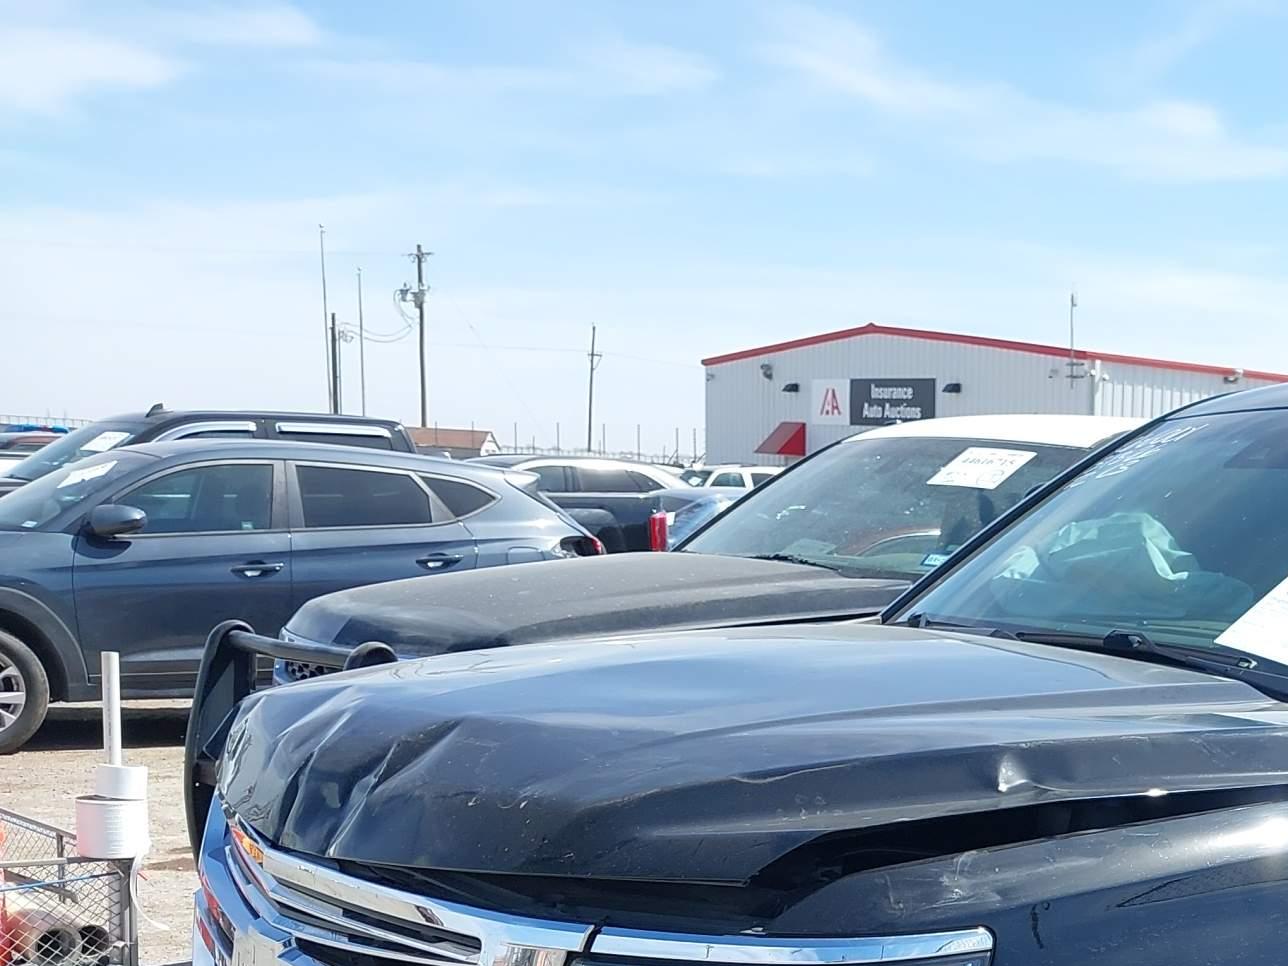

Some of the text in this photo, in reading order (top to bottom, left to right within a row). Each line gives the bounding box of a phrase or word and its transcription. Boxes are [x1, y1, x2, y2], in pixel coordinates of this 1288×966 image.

[870, 383, 914, 400] Insurance
[862, 402, 922, 419] Auto Auctions
